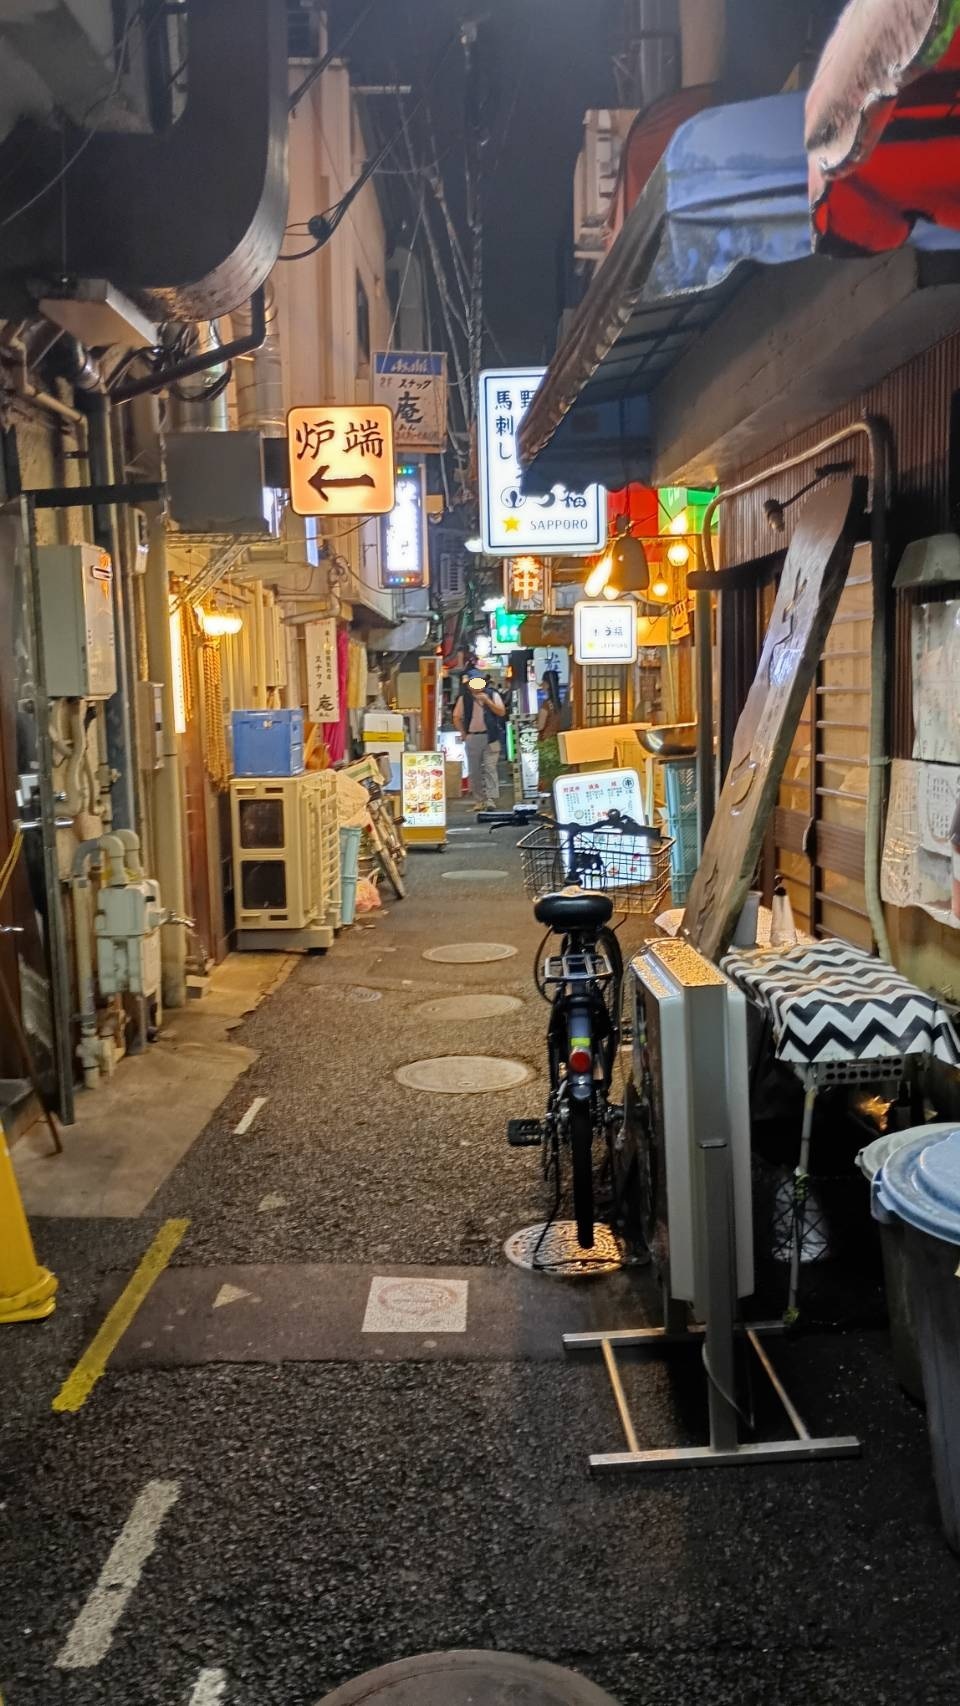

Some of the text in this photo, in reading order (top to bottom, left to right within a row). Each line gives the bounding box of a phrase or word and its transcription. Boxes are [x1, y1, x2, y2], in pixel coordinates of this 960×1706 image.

[398, 377, 432, 390] スナック
[395, 391, 423, 424] 庵
[295, 419, 384, 461] 炉端
[494, 390, 514, 461] 馬刺し
[529, 518, 588, 532] SAPPORO
